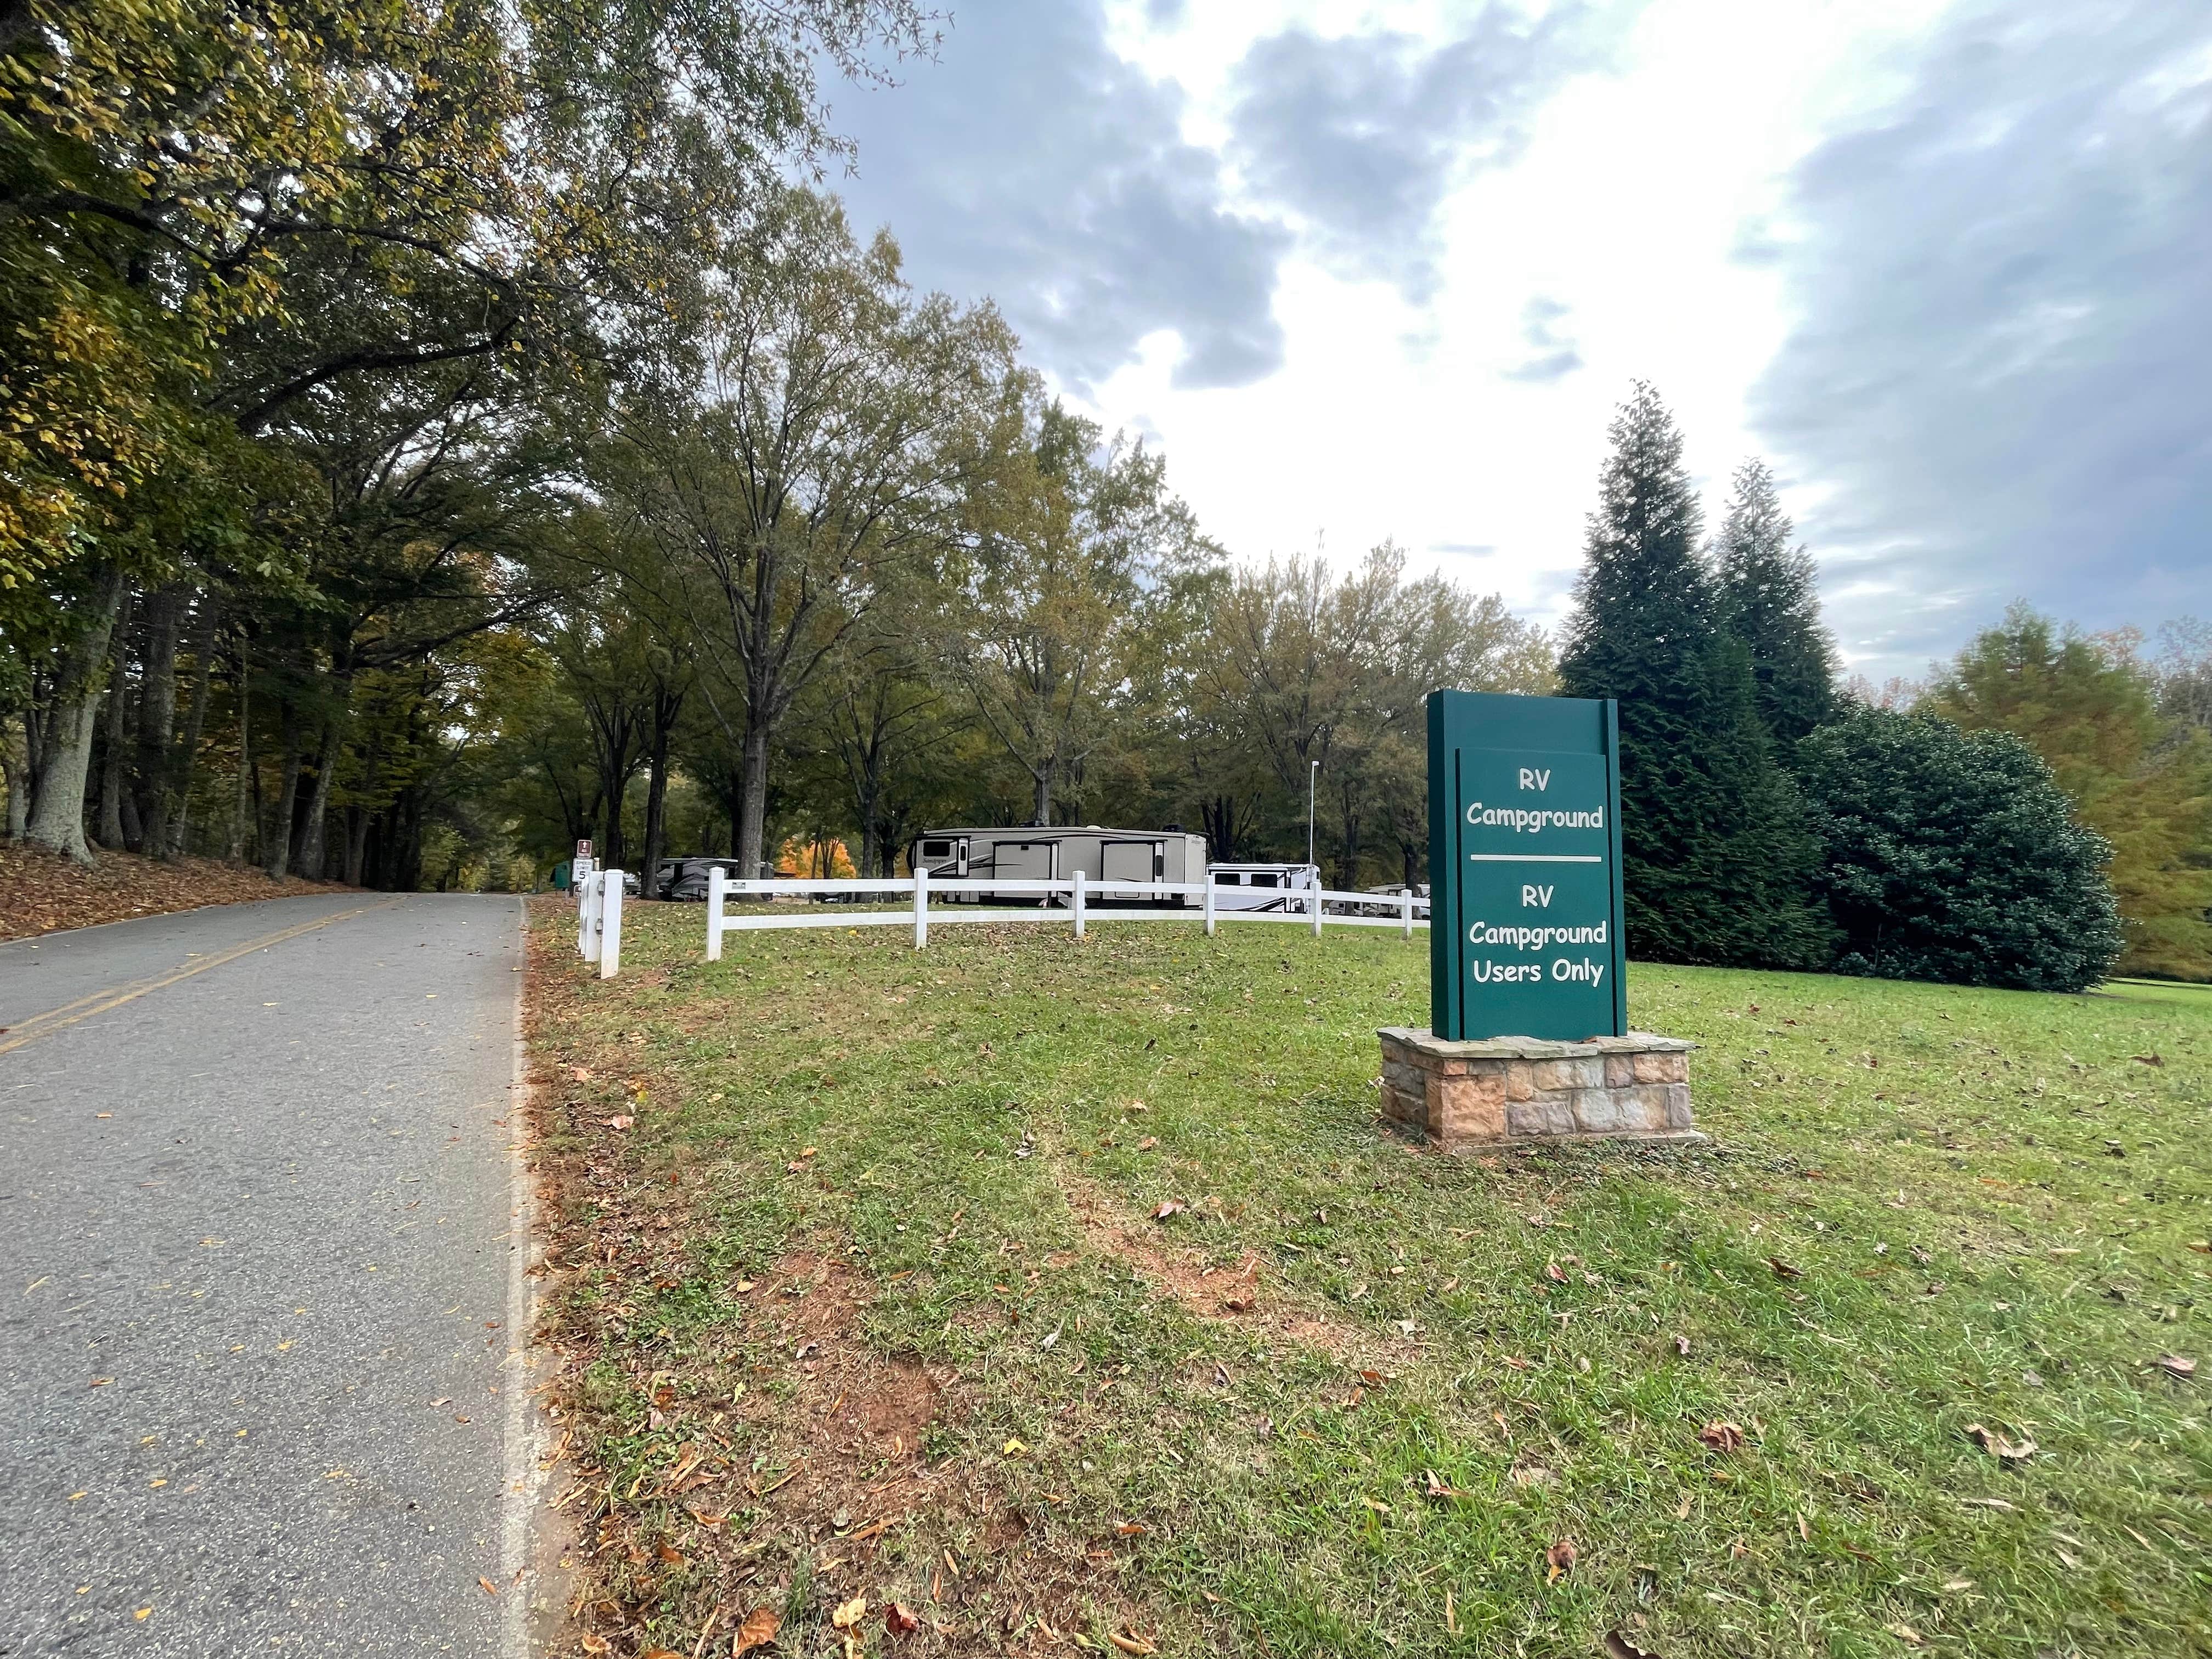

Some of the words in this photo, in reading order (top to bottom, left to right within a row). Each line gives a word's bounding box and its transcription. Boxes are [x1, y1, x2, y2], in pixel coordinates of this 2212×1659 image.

[1519, 768, 1551, 792] RV
[1466, 802, 1603, 833] Campground
[579, 871, 586, 879] 5
[1522, 884, 1554, 908] RV
[1469, 920, 1607, 951] Campground
[1474, 960, 1542, 983] Users
[1551, 957, 1604, 988] Only
